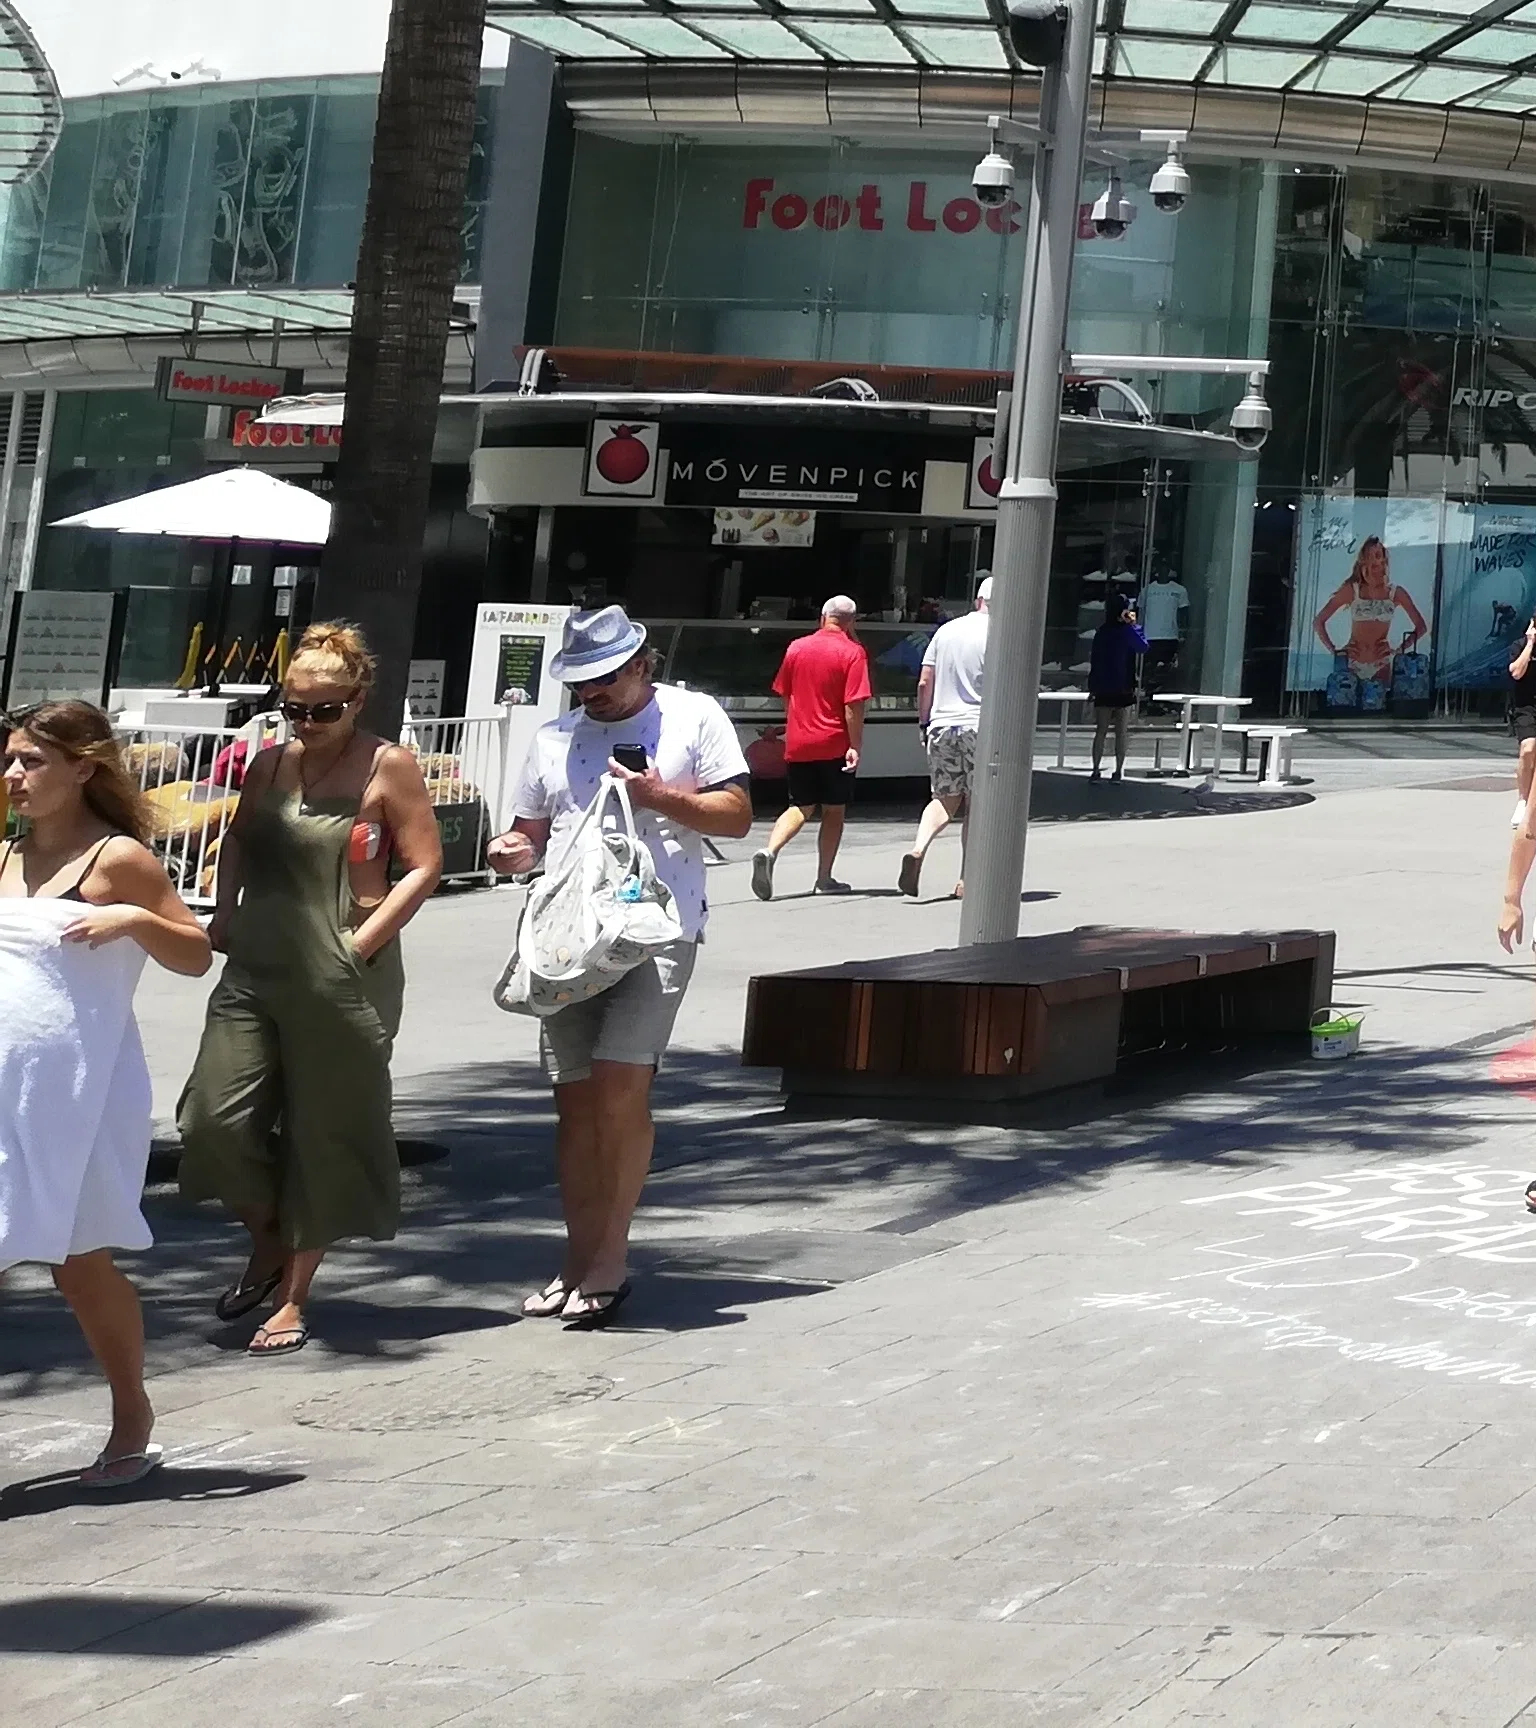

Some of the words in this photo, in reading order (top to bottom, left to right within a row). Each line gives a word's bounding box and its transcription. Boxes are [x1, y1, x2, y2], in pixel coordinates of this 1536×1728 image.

[742, 177, 884, 232] Foot
[172, 371, 215, 393] Foot
[218, 375, 280, 397] Locker
[1453, 387, 1513, 408] RIP
[1470, 534, 1508, 553] MADE
[1474, 549, 1527, 573] WAVES
[437, 816, 464, 844] ES
[1170, 1235, 1421, 1288] 40
